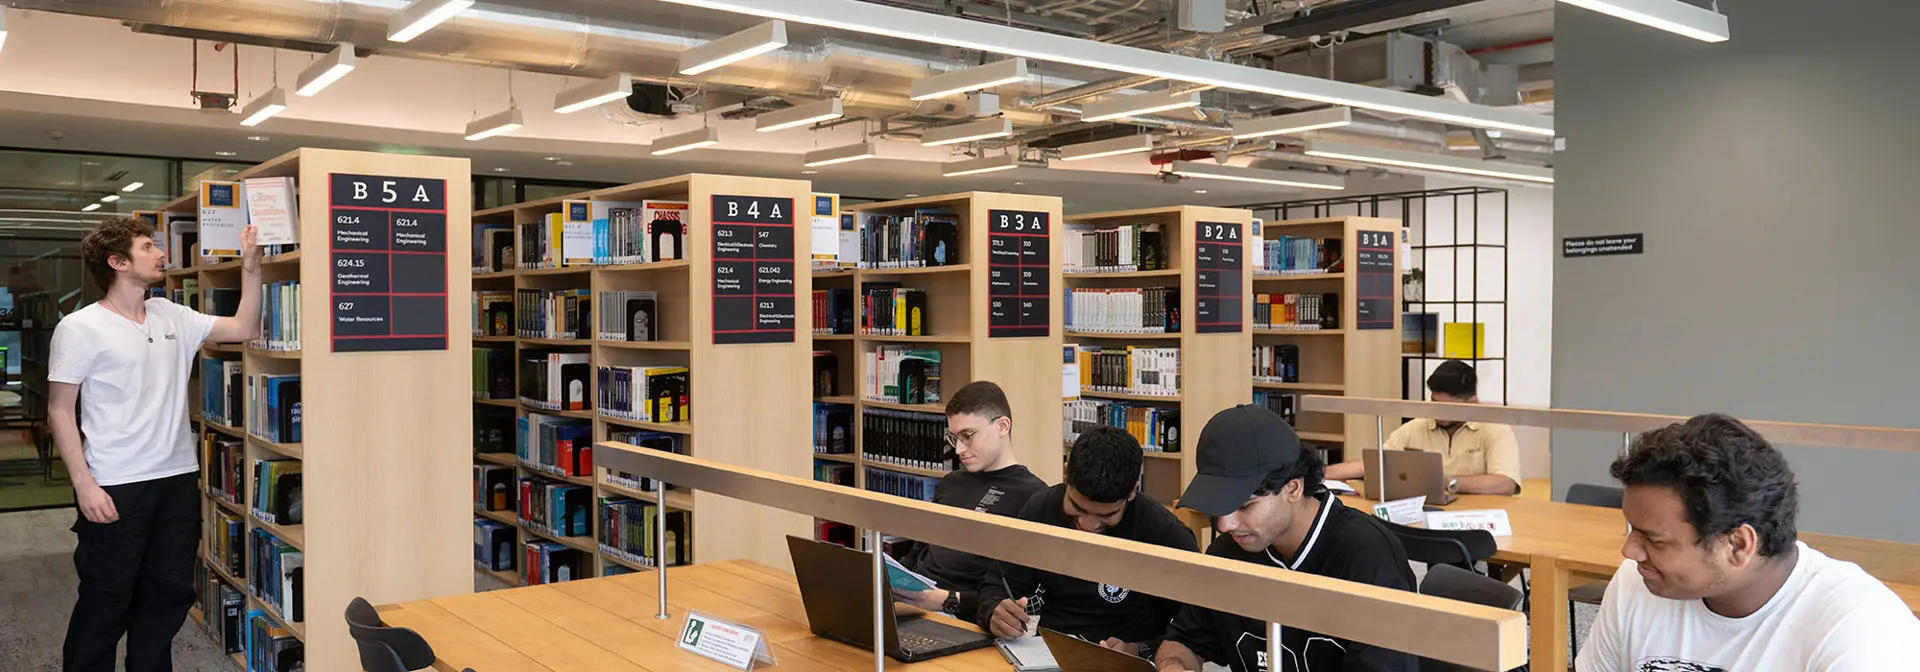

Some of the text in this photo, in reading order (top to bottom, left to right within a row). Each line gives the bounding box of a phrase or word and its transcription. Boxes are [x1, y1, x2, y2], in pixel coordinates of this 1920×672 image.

[353, 180, 430, 203] B 5 A
[727, 200, 783, 219] B 4 A
[337, 216, 360, 224] 621.4
[653, 210, 680, 221] CHASSIS
[396, 218, 418, 227] 621.4
[1000, 213, 1042, 231] B 3 A
[1205, 224, 1237, 240] B 2 A
[337, 236, 370, 244] Engineering
[396, 238, 427, 246] Engineering
[1362, 232, 1388, 247] B 1 A
[1565, 244, 1633, 254] belongings unattended
[337, 259, 365, 267] 624.15
[717, 266, 734, 274] 621.4
[338, 302, 354, 310] 627
